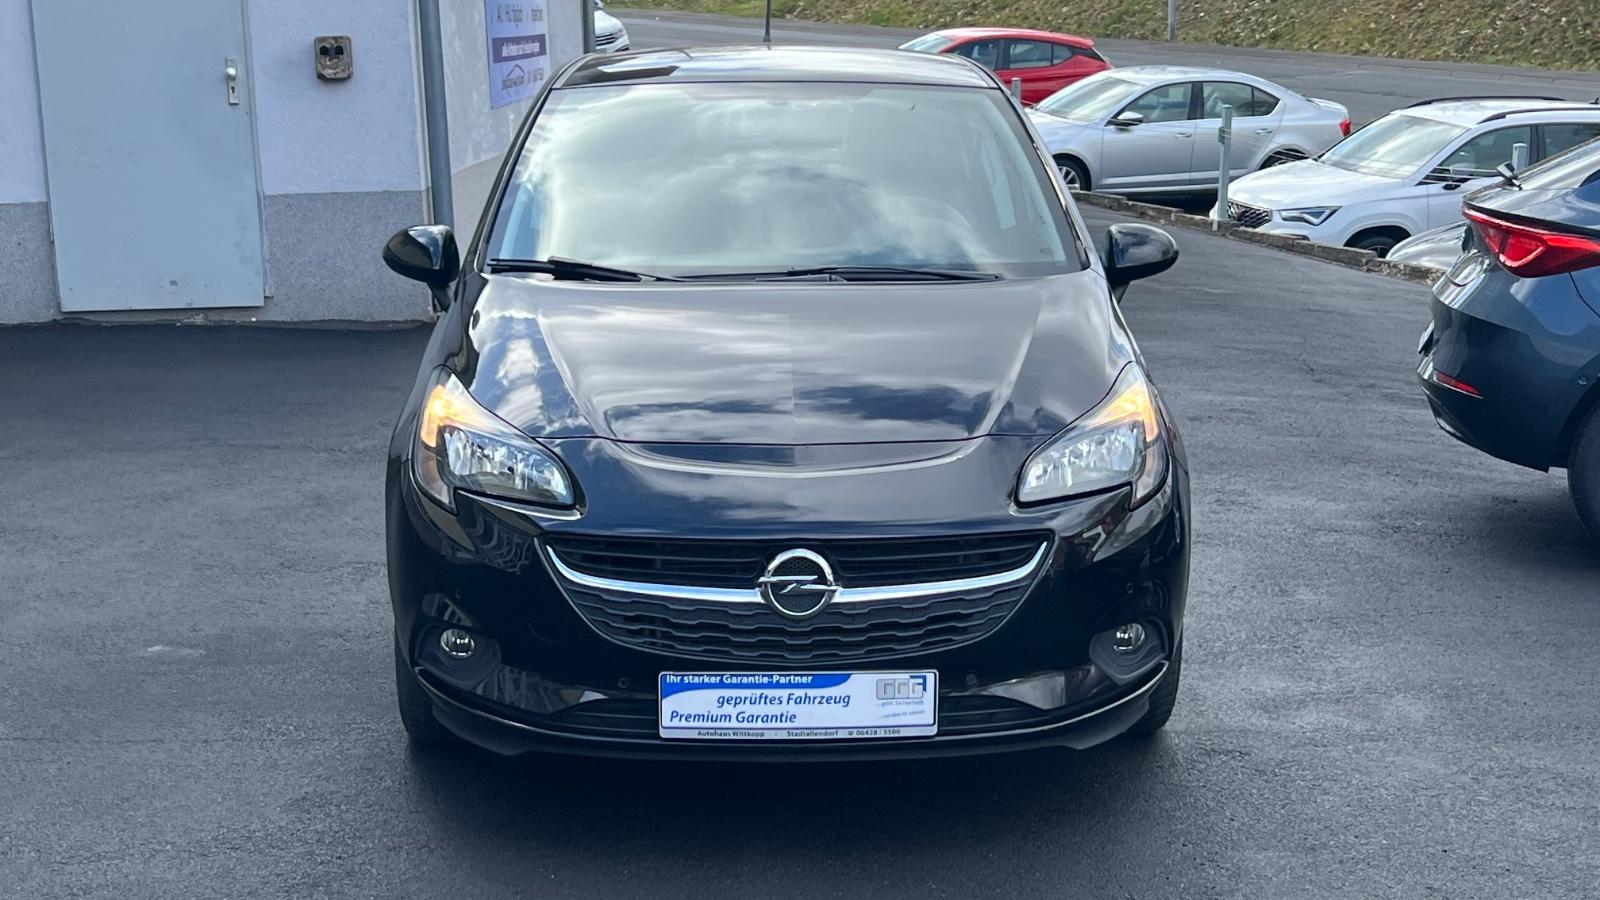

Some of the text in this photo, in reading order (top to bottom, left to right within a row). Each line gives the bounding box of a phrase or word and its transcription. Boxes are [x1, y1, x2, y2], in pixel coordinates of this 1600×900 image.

[666, 674, 813, 684] Ihr starker Garantie-Partner
[717, 692, 851, 708] geprüftes Fahrzeug
[670, 710, 797, 724] Premium Garantie
[697, 730, 731, 738] Autohaus
